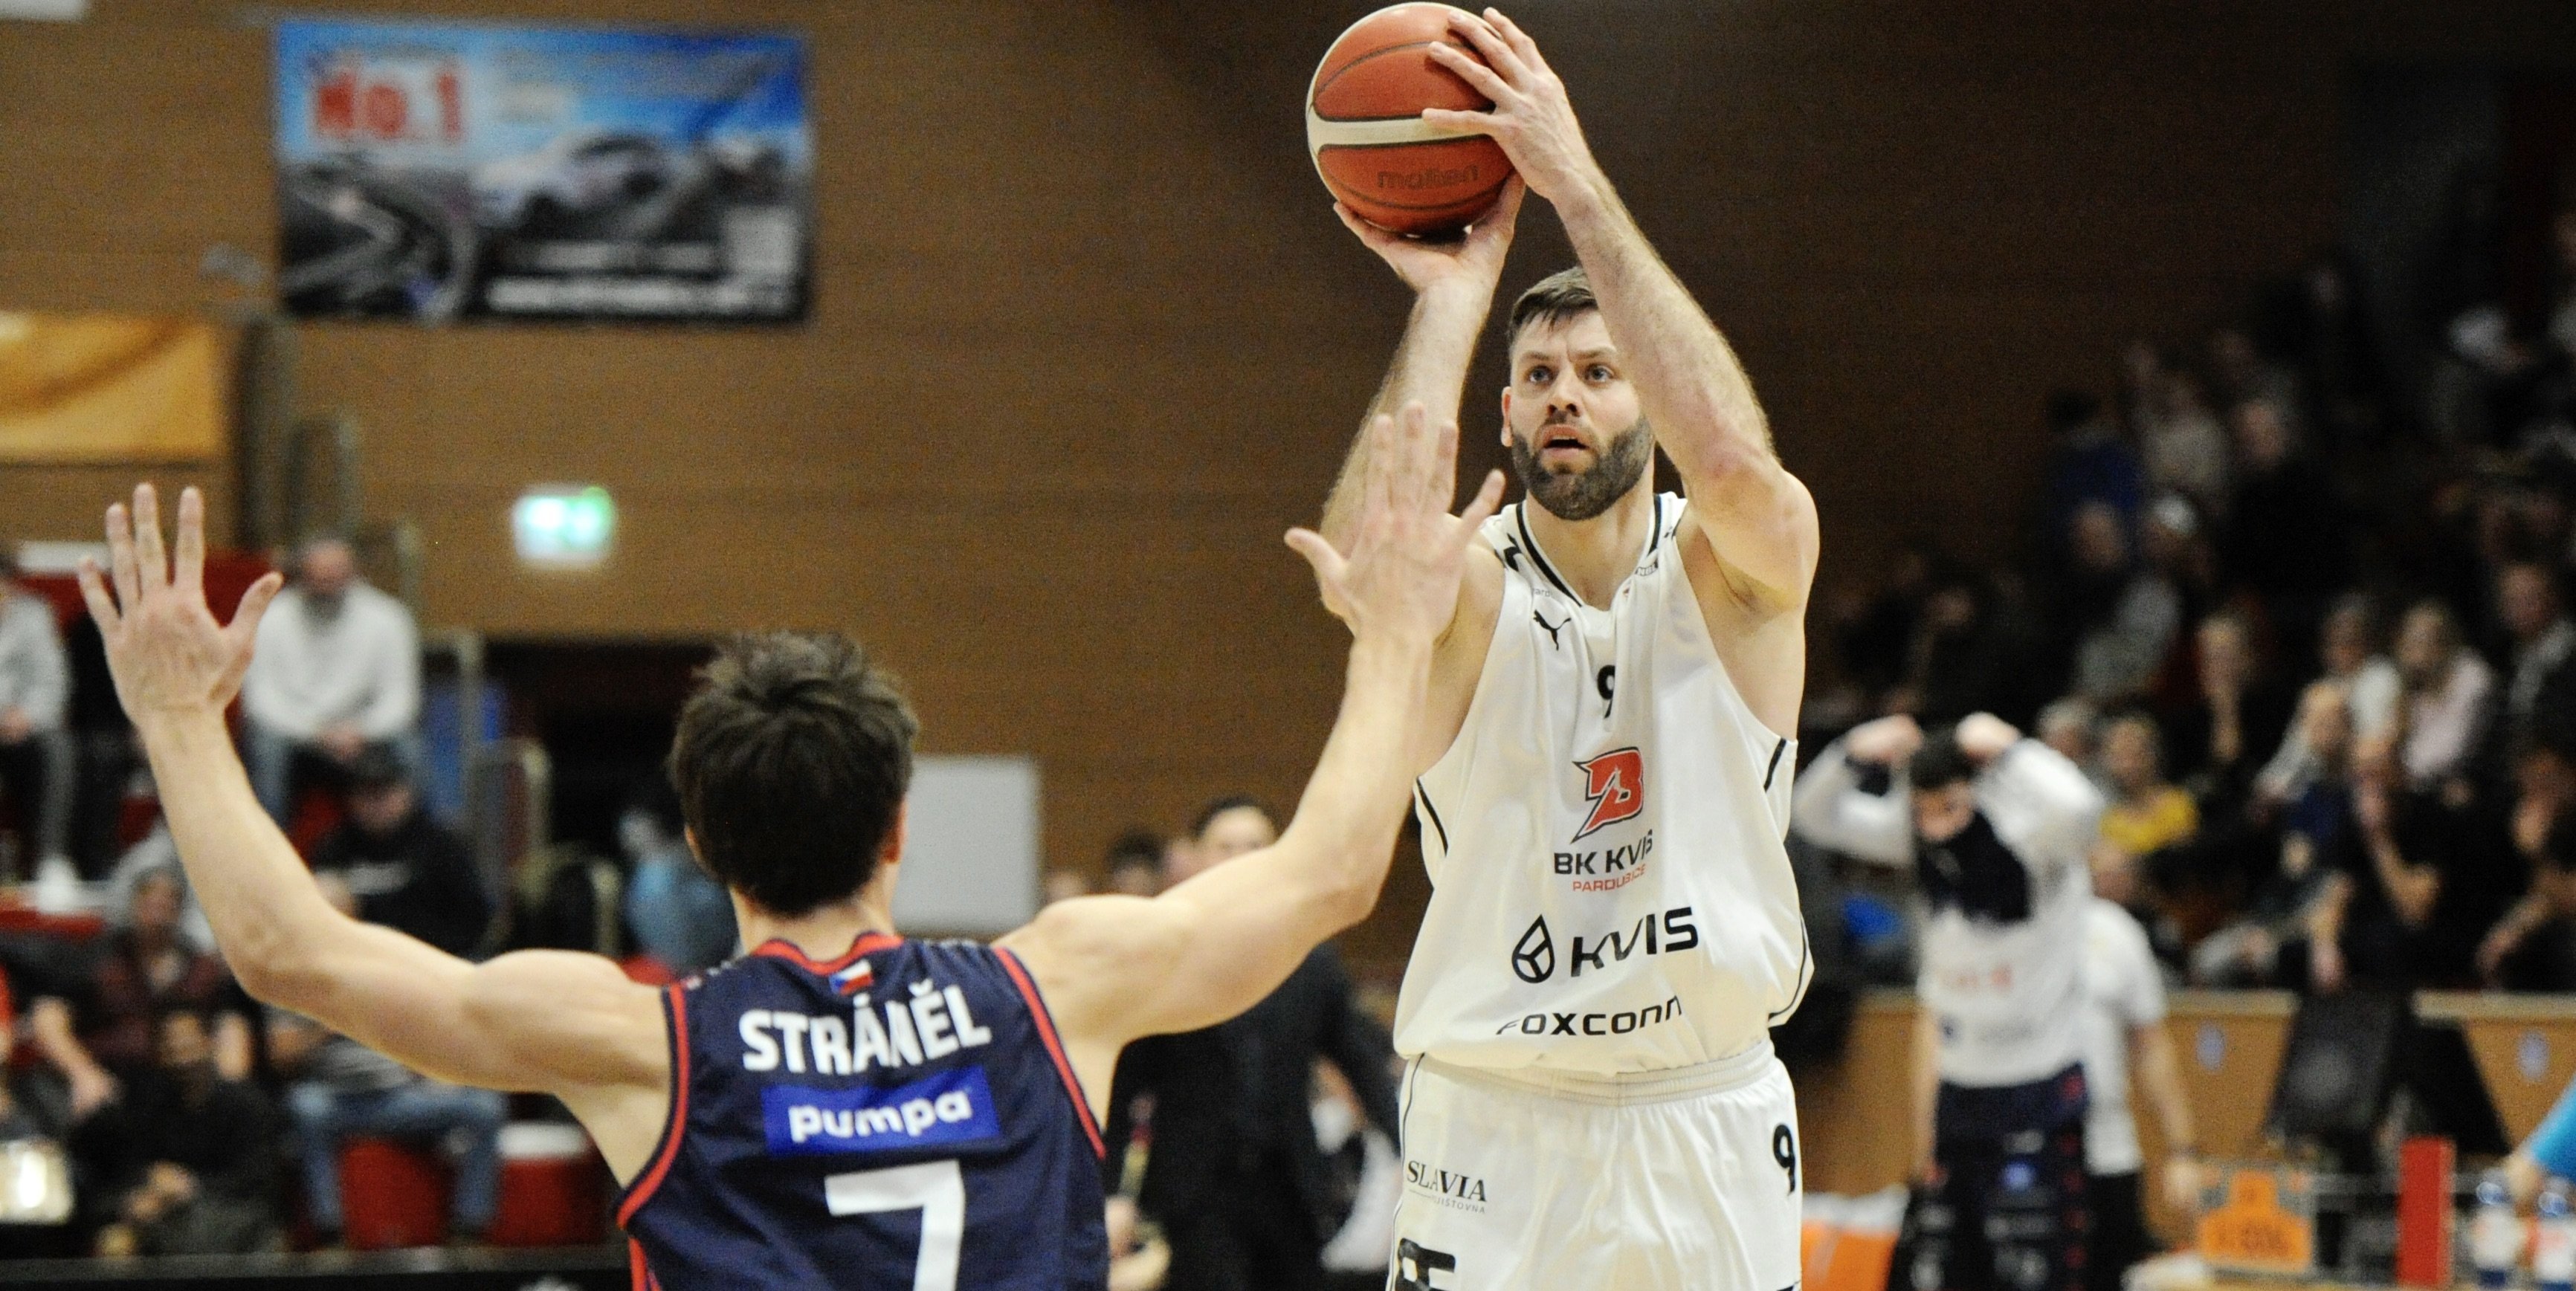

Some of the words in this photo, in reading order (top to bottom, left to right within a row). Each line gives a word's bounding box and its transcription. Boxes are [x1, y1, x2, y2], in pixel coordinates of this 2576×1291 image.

[1378, 164, 1479, 190] molten
[1597, 664, 1615, 719] 9
[1554, 852, 1598, 875] BK
[1606, 829, 1653, 873] KVIS
[1571, 906, 1699, 977] KVIS
[739, 978, 992, 1075] STRÁNĚL
[788, 1090, 973, 1143] pumpa
[1407, 1160, 1487, 1203] SLAVIA
[1773, 1124, 1795, 1197] 9
[824, 1159, 966, 1291] 7
